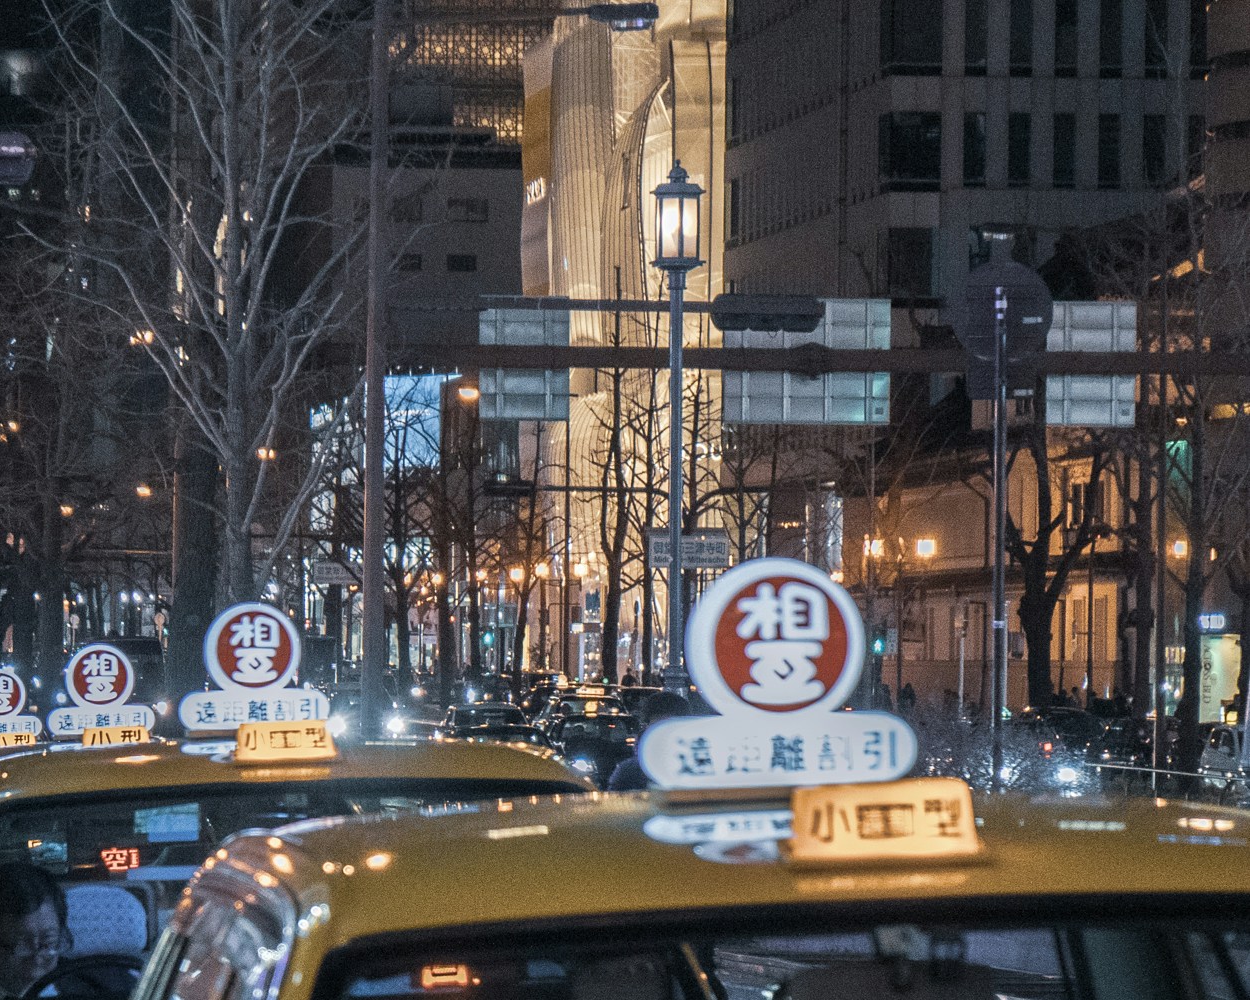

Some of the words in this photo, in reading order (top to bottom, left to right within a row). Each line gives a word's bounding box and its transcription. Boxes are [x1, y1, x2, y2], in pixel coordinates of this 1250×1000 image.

[195, 698, 320, 724] 遠距離割引
